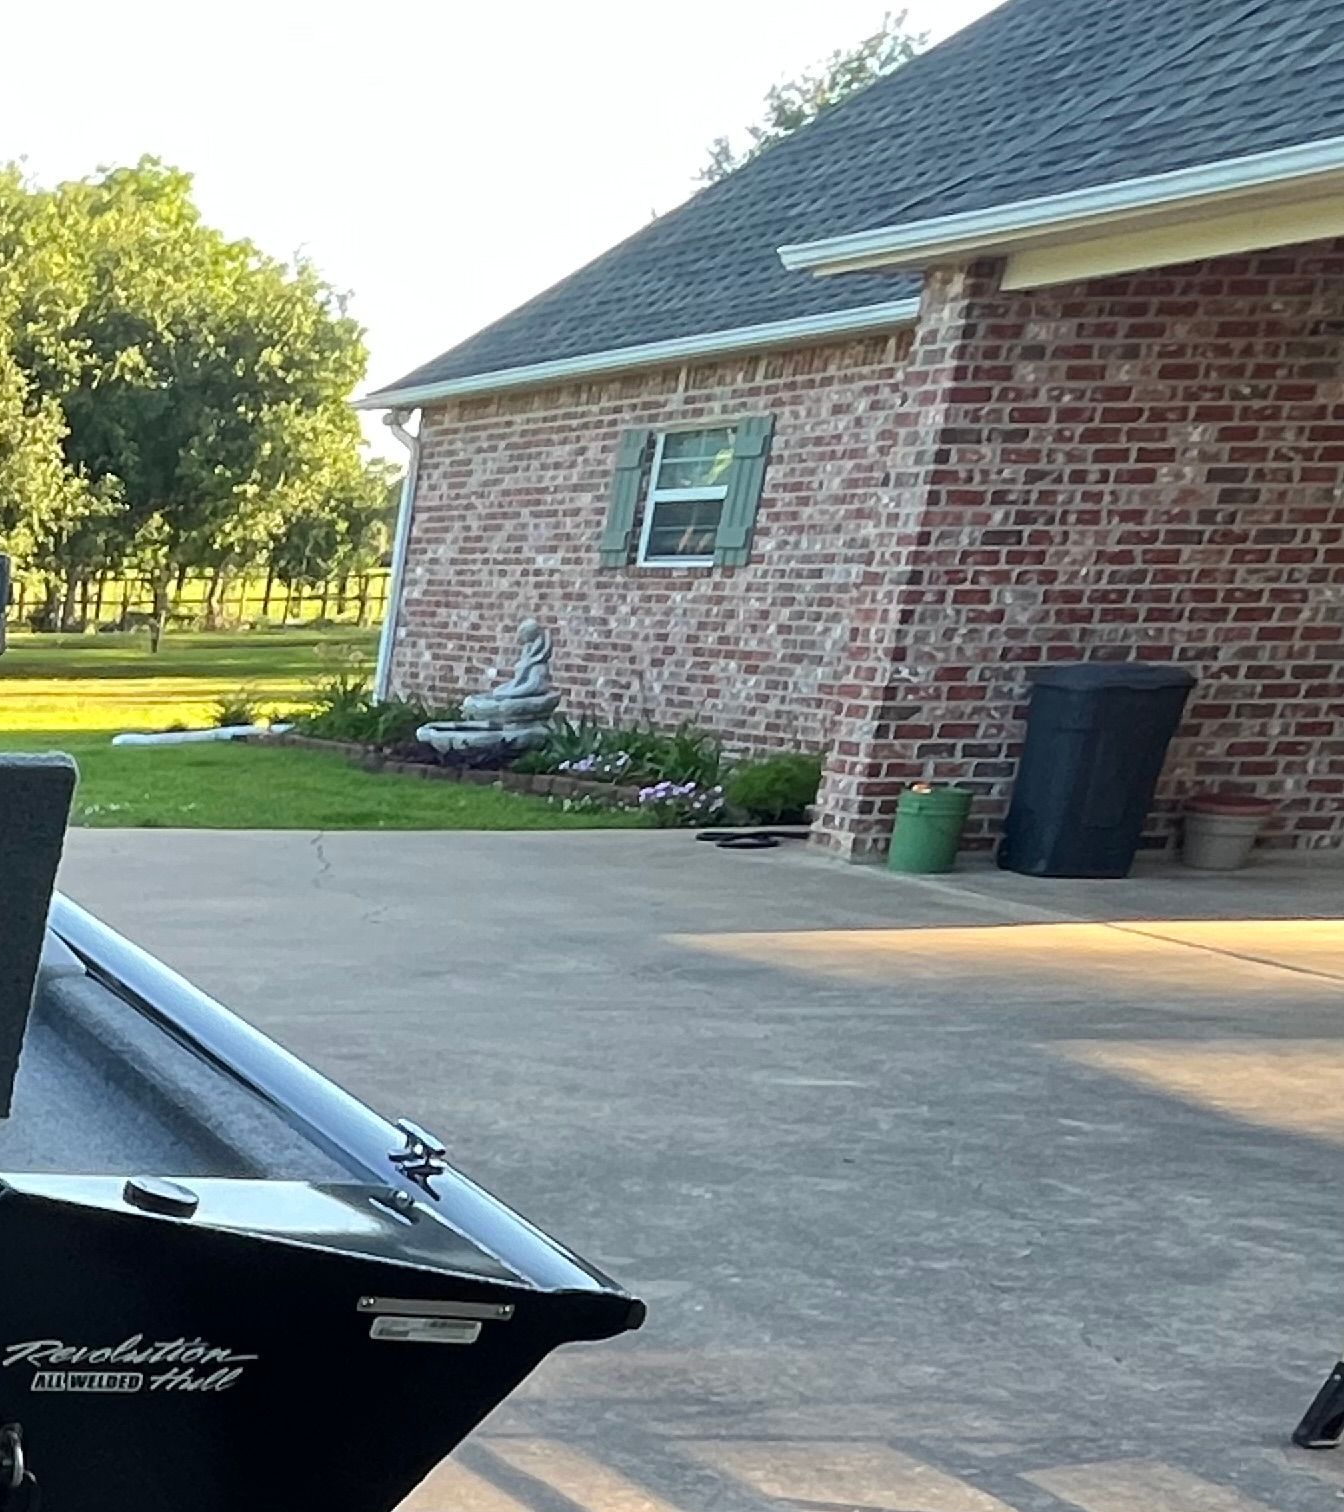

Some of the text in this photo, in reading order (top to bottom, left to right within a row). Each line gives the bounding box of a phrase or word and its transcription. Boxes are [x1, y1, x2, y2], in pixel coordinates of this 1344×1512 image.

[2, 1333, 260, 1368] Revolution
[32, 1366, 244, 1392] ALL WELDED Hull
